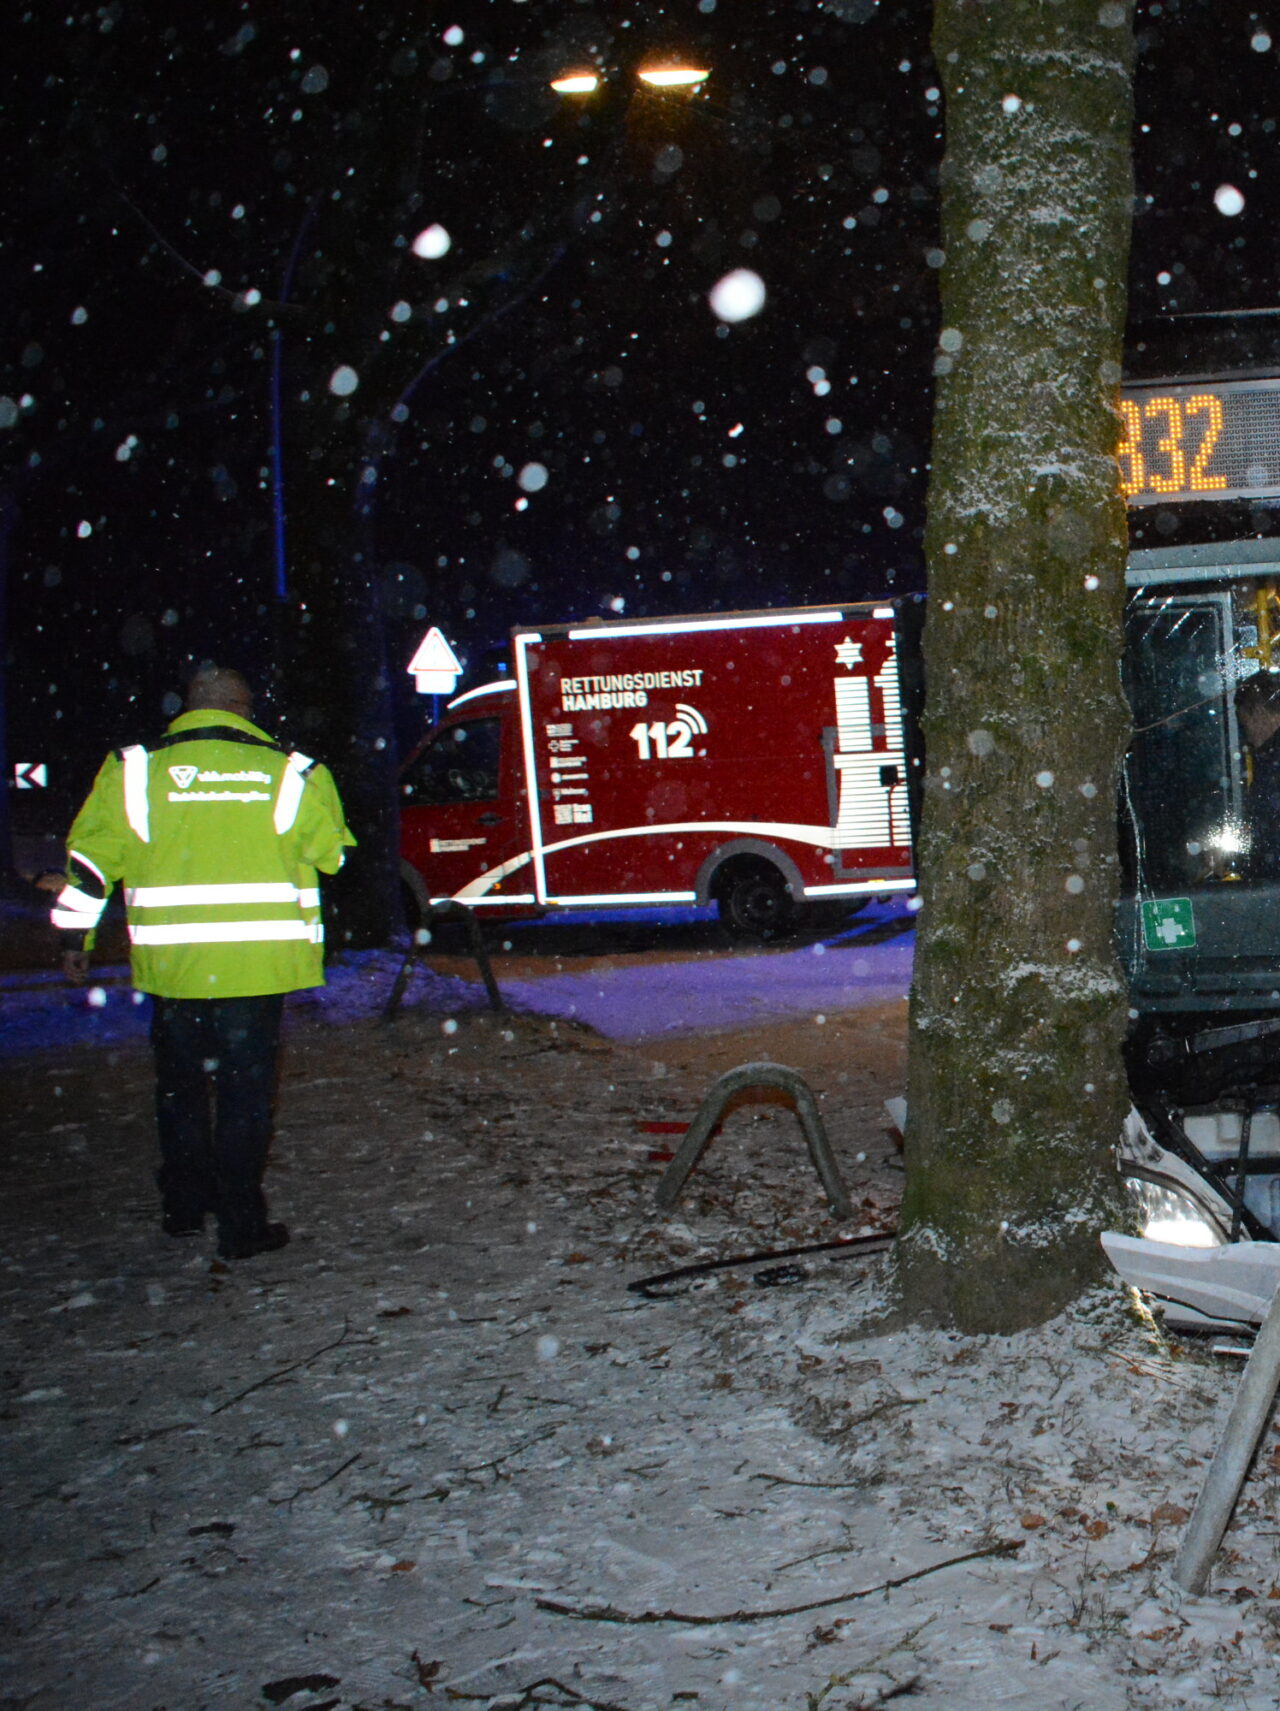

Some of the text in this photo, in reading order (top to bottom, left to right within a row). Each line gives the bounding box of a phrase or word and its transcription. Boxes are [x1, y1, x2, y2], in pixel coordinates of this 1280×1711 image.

[560, 669, 704, 695] RETTUNGSDIENST
[561, 690, 649, 712] HAMBURG
[629, 720, 694, 760] 112
